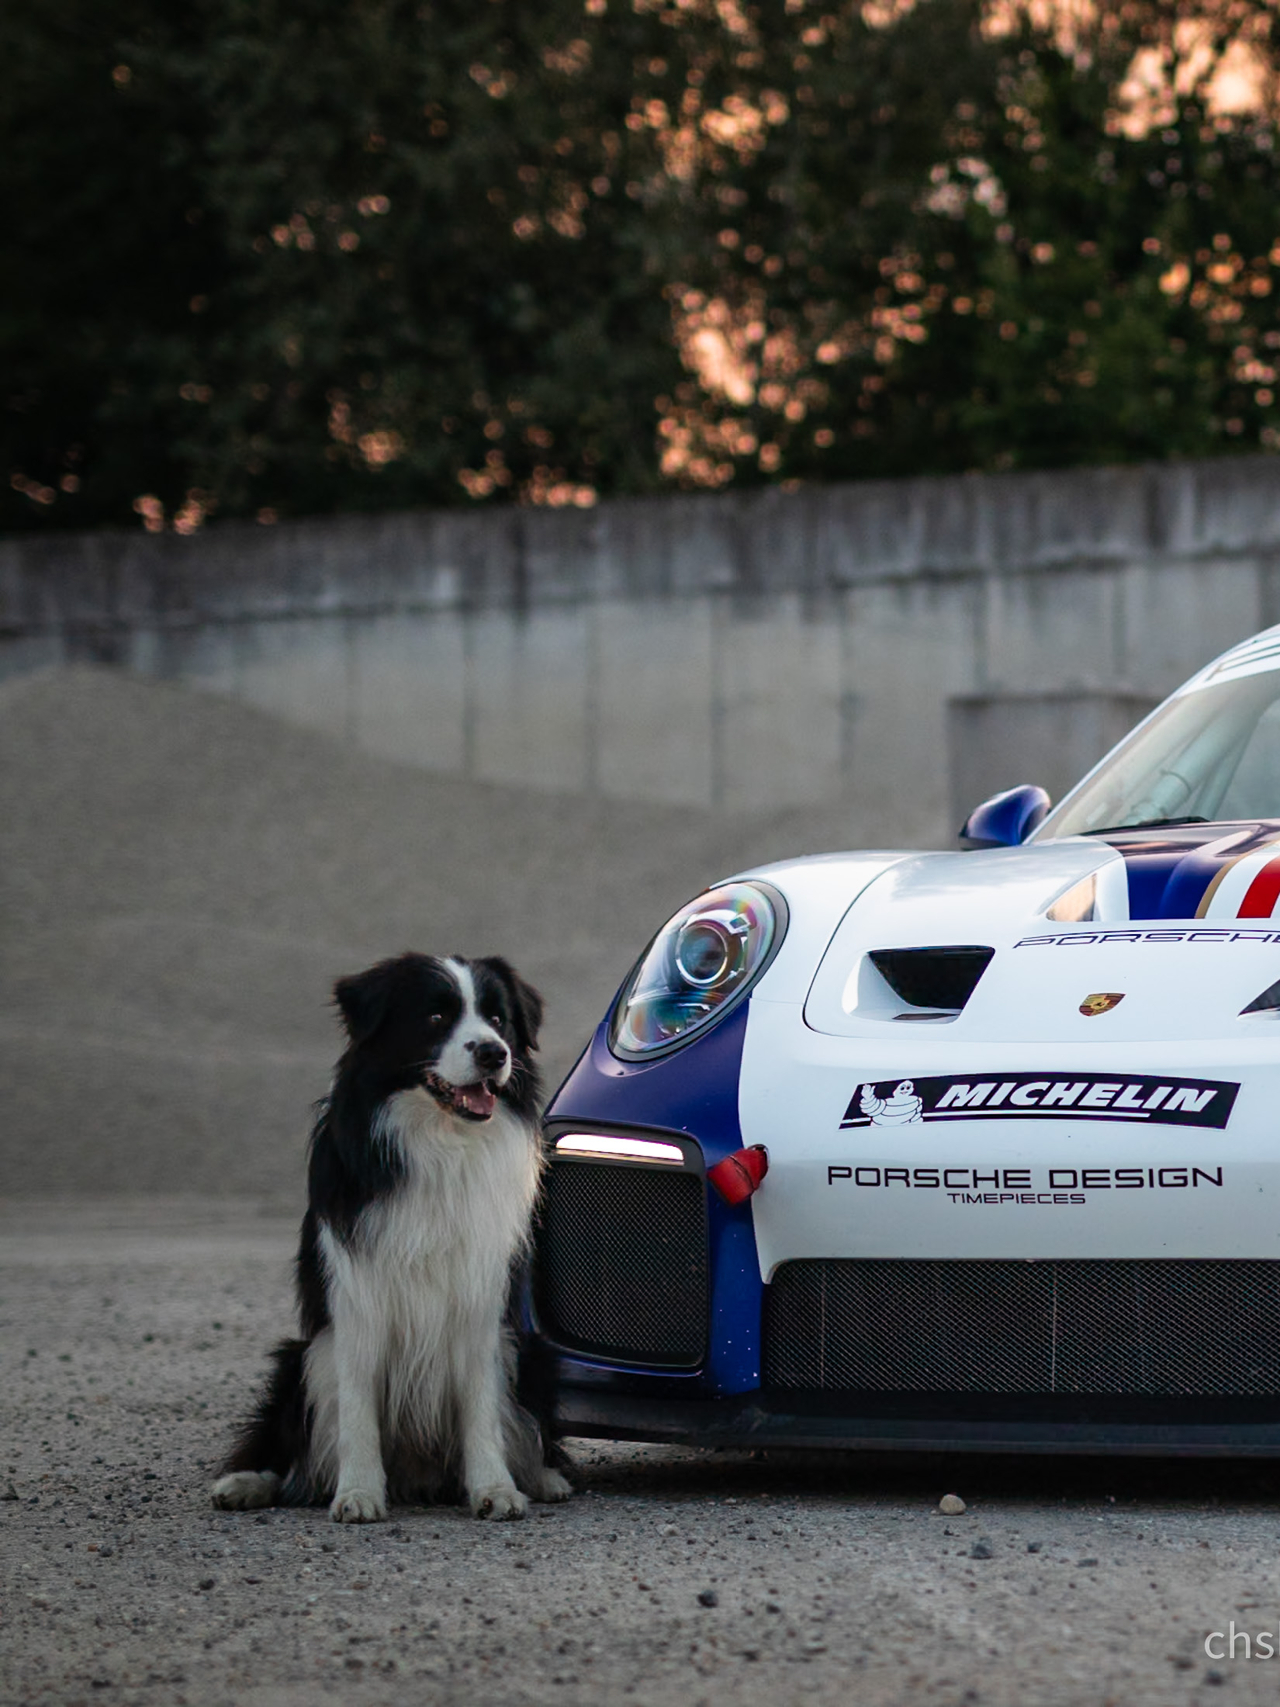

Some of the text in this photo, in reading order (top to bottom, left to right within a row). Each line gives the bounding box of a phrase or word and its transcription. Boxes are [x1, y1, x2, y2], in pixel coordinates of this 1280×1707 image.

[936, 1081, 1217, 1112] MICHELIN
[828, 1166, 1223, 1189] PORSCHE DESIGN
[947, 1193, 1086, 1205] TIMEPIECES
